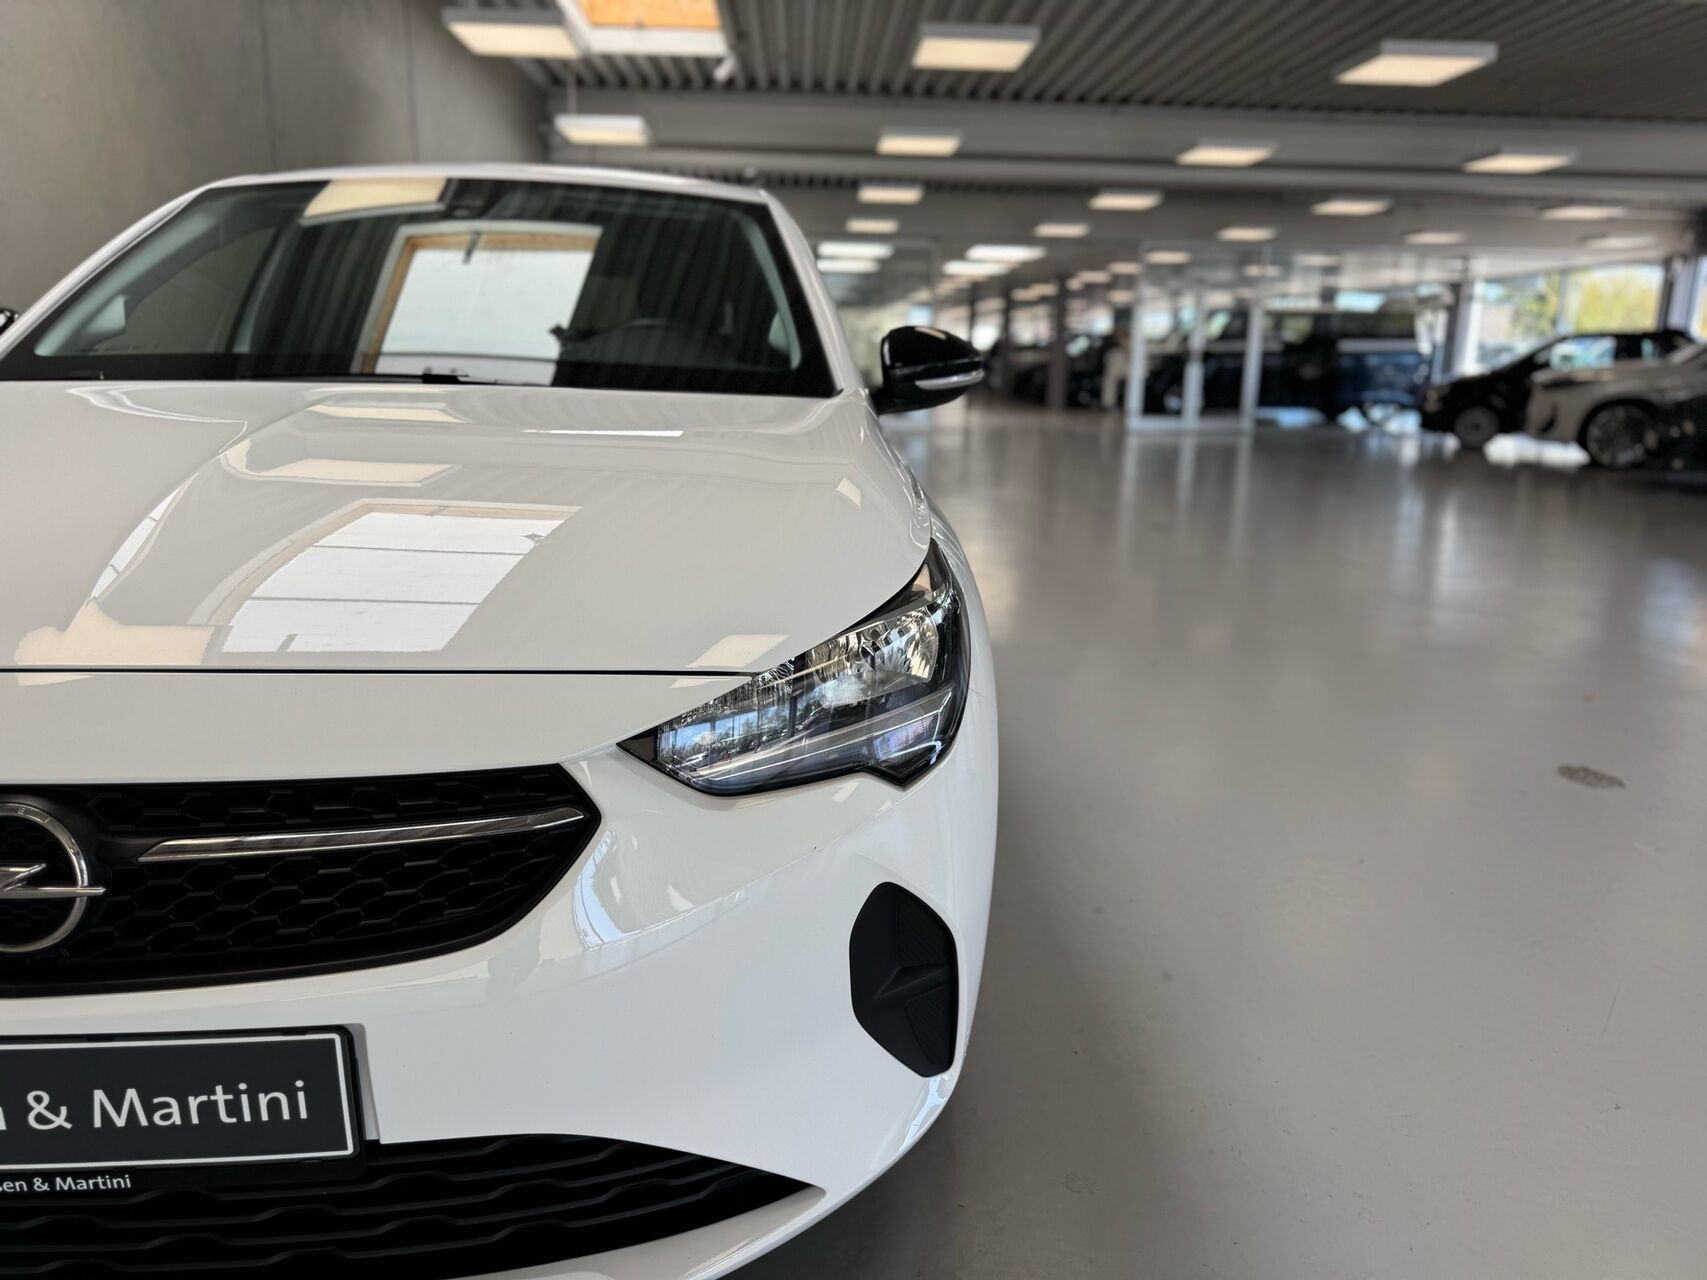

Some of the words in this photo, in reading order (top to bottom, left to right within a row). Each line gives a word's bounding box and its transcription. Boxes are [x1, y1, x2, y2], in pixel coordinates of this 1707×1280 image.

[26, 1090, 73, 1130] &
[93, 1080, 308, 1129] Martini
[33, 1177, 50, 1192] &
[55, 1174, 132, 1191] Martini
